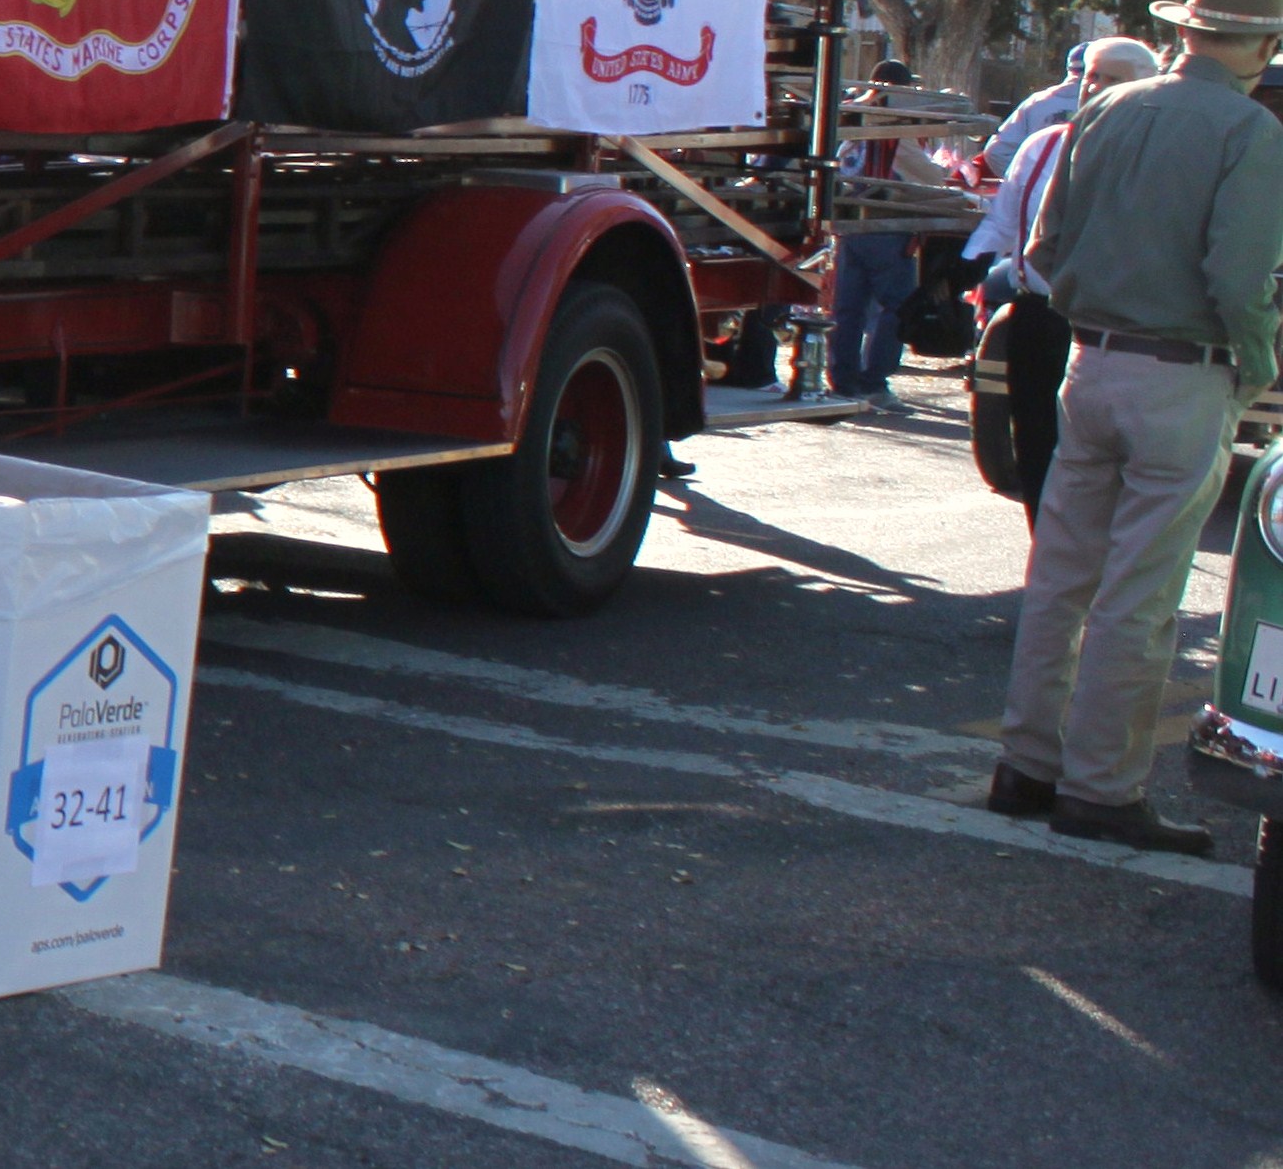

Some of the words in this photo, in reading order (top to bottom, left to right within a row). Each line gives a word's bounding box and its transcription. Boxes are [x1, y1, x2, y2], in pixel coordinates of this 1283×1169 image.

[6, 27, 64, 71] STATES
[71, 36, 123, 72] MARINE
[592, 55, 627, 77] UNITED
[629, 50, 664, 70] STATES
[666, 61, 699, 80] ARMY
[629, 83, 650, 105] 1775
[51, 783, 126, 829] 32-41
